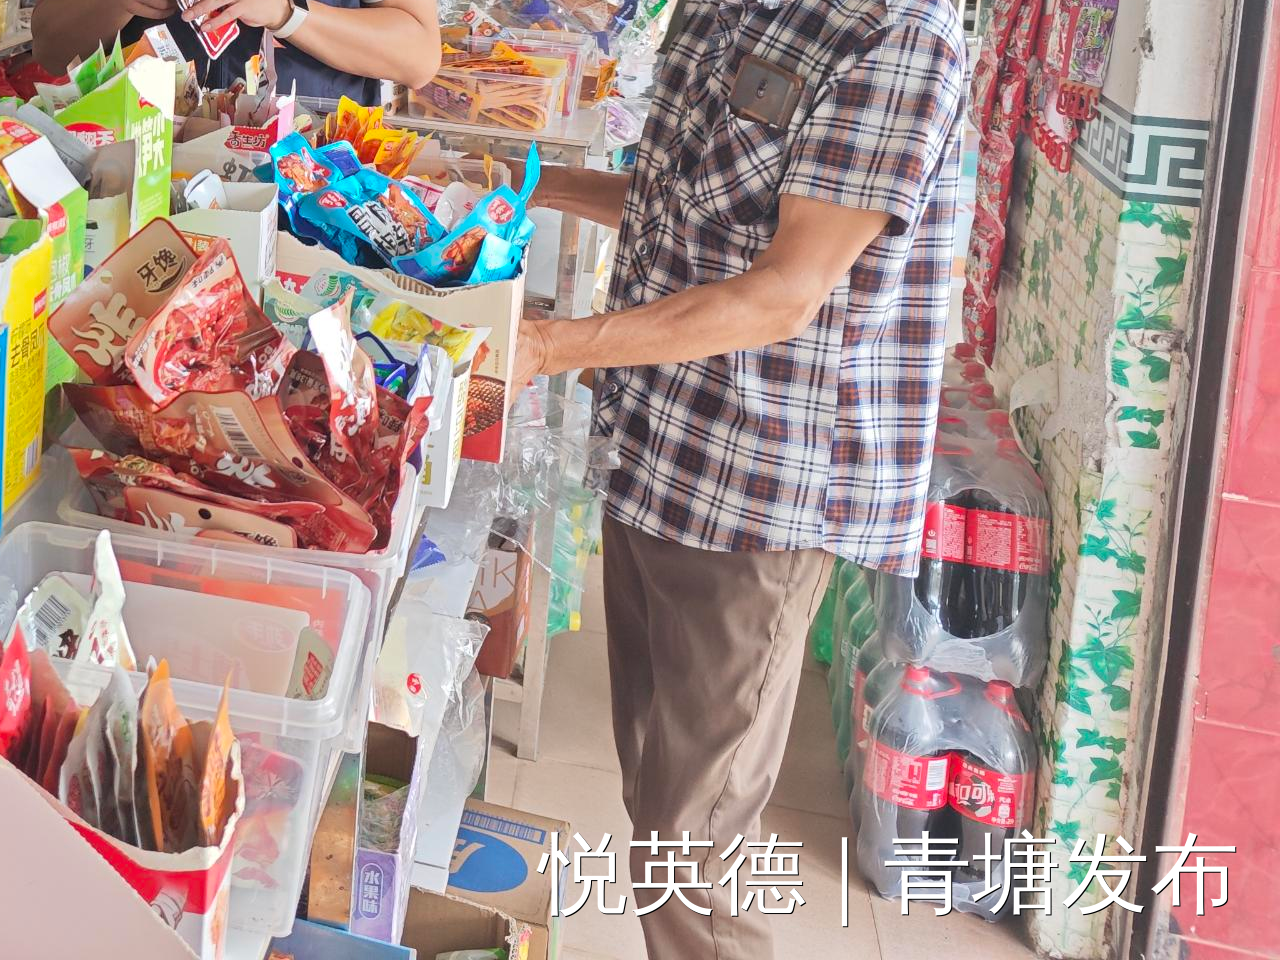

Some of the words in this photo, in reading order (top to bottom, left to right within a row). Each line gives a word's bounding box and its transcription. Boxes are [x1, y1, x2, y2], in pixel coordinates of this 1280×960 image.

[137, 248, 178, 288] 牙馋
[362, 870, 383, 916] 水果味
